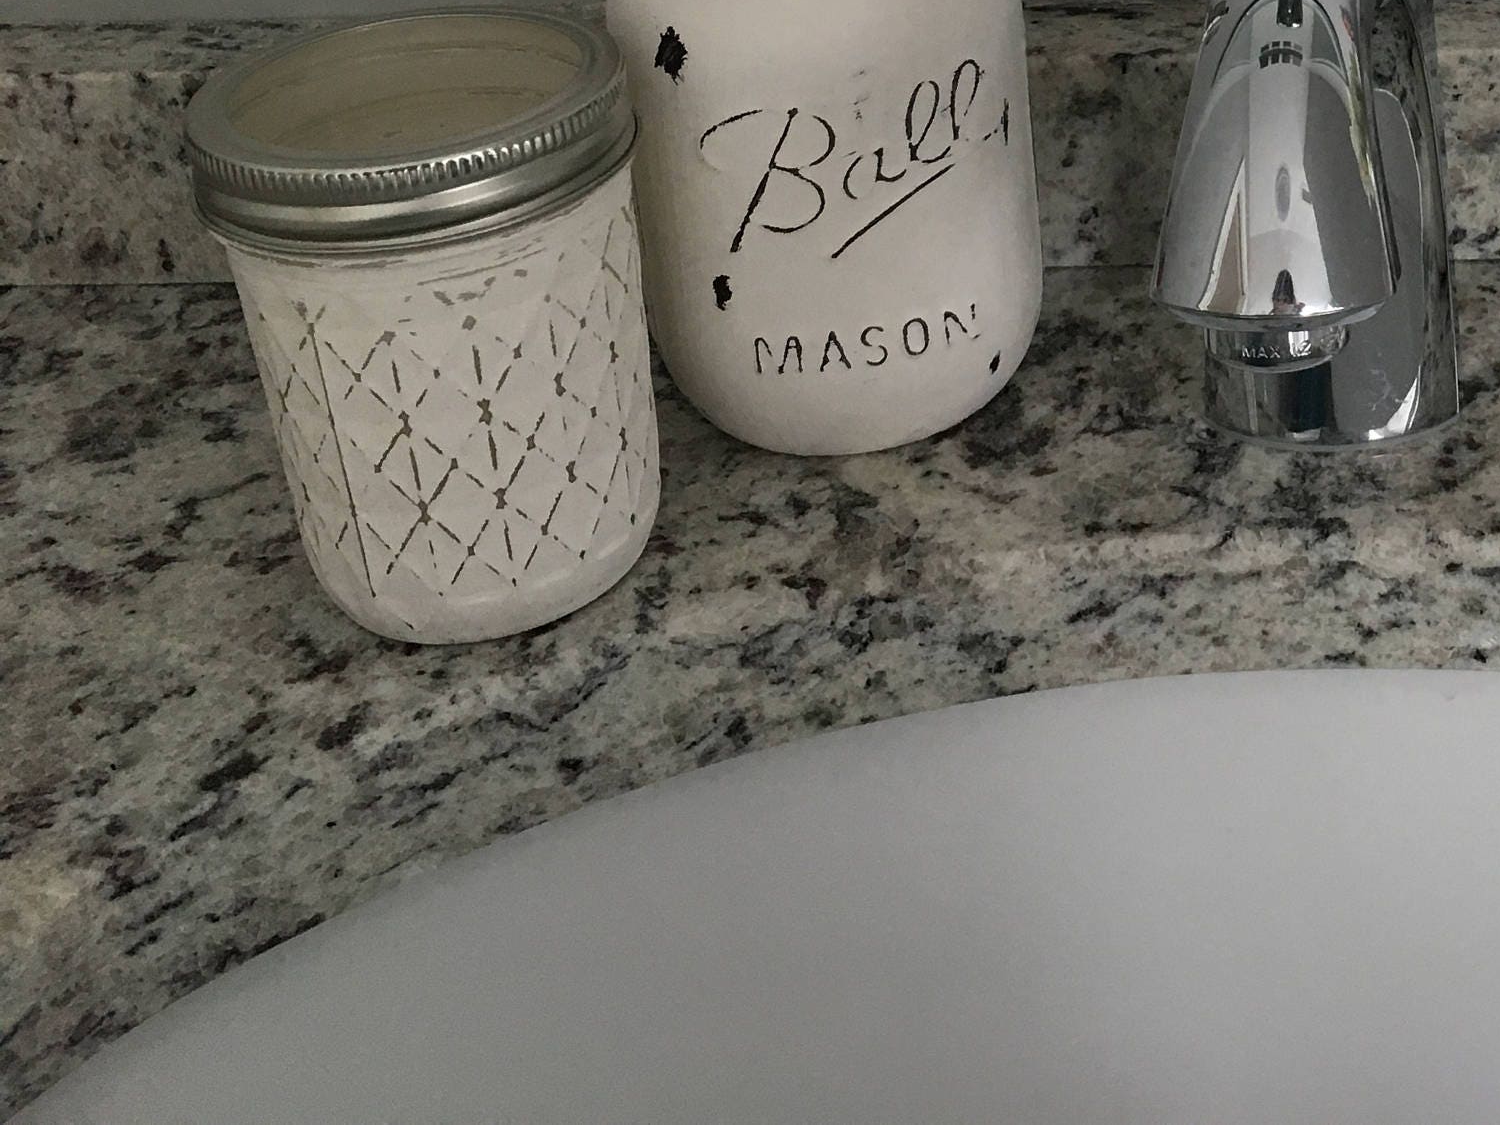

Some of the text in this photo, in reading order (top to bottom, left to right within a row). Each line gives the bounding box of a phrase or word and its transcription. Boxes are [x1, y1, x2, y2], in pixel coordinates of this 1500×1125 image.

[700, 59, 998, 255] Ball
[754, 304, 979, 374] MASON
[1242, 346, 1281, 359] MAX
